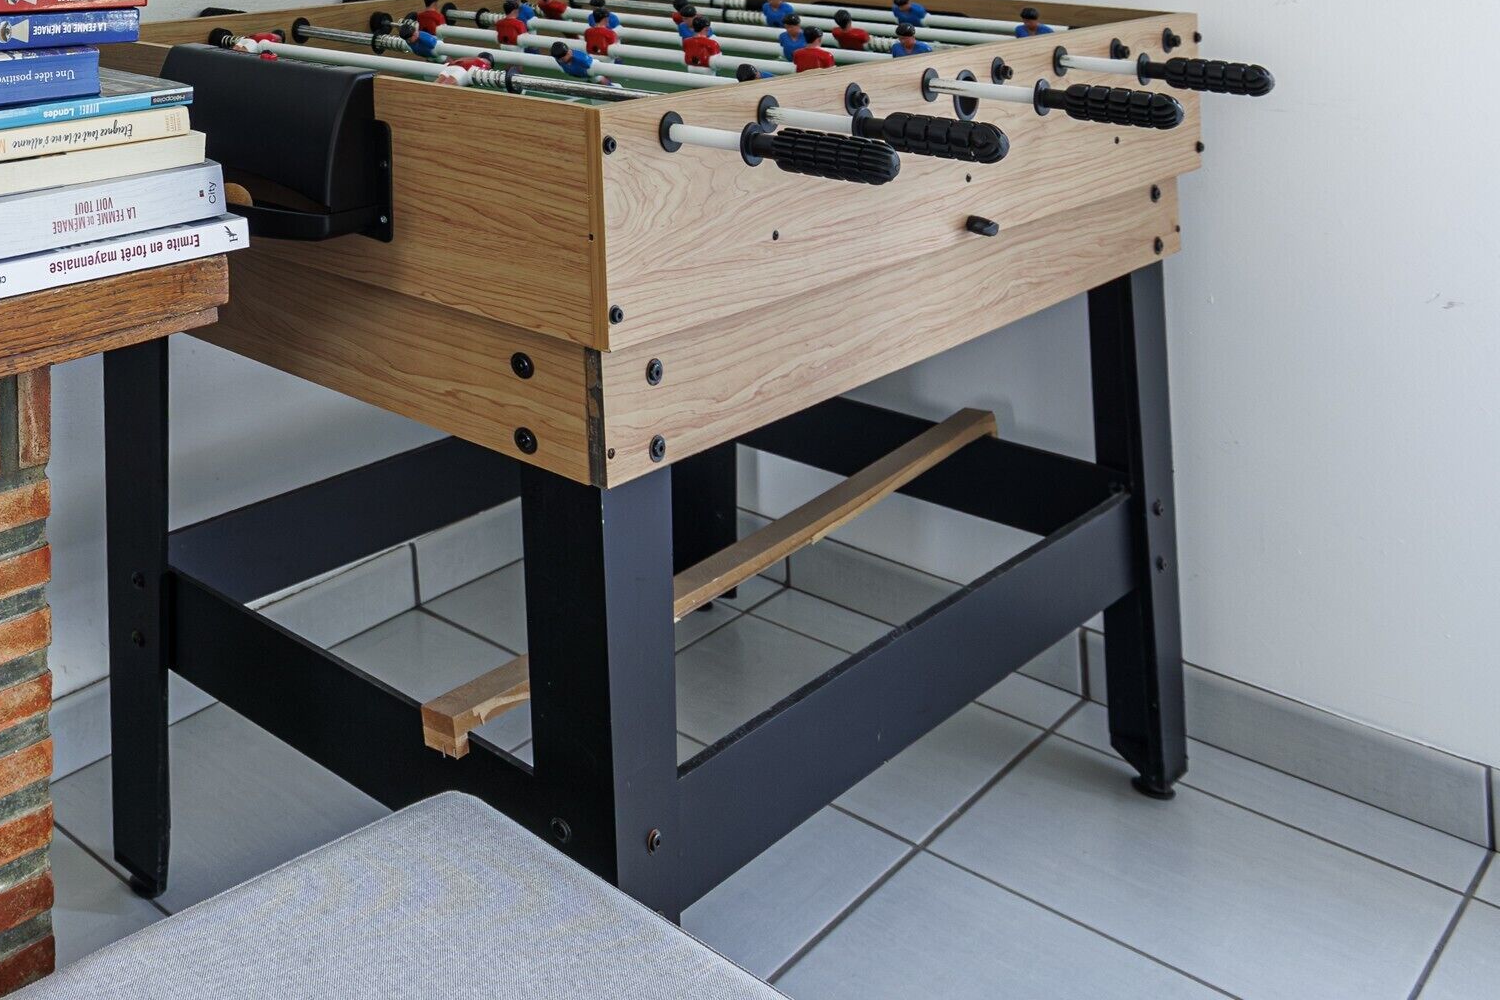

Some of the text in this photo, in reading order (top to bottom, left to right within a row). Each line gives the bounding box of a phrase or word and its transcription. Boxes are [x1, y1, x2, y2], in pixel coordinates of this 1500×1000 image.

[72, 23, 96, 33] FEMME
[34, 71, 54, 83] idée
[55, 69, 76, 80] Une
[43, 107, 75, 119] Landes
[11, 129, 99, 150] tout s'allume
[208, 181, 217, 204] City
[74, 197, 113, 216] VOIT TOUT
[52, 207, 136, 235] LA FEMME MÉNAGE
[49, 233, 200, 275] Ermite en forêt mayennaise
